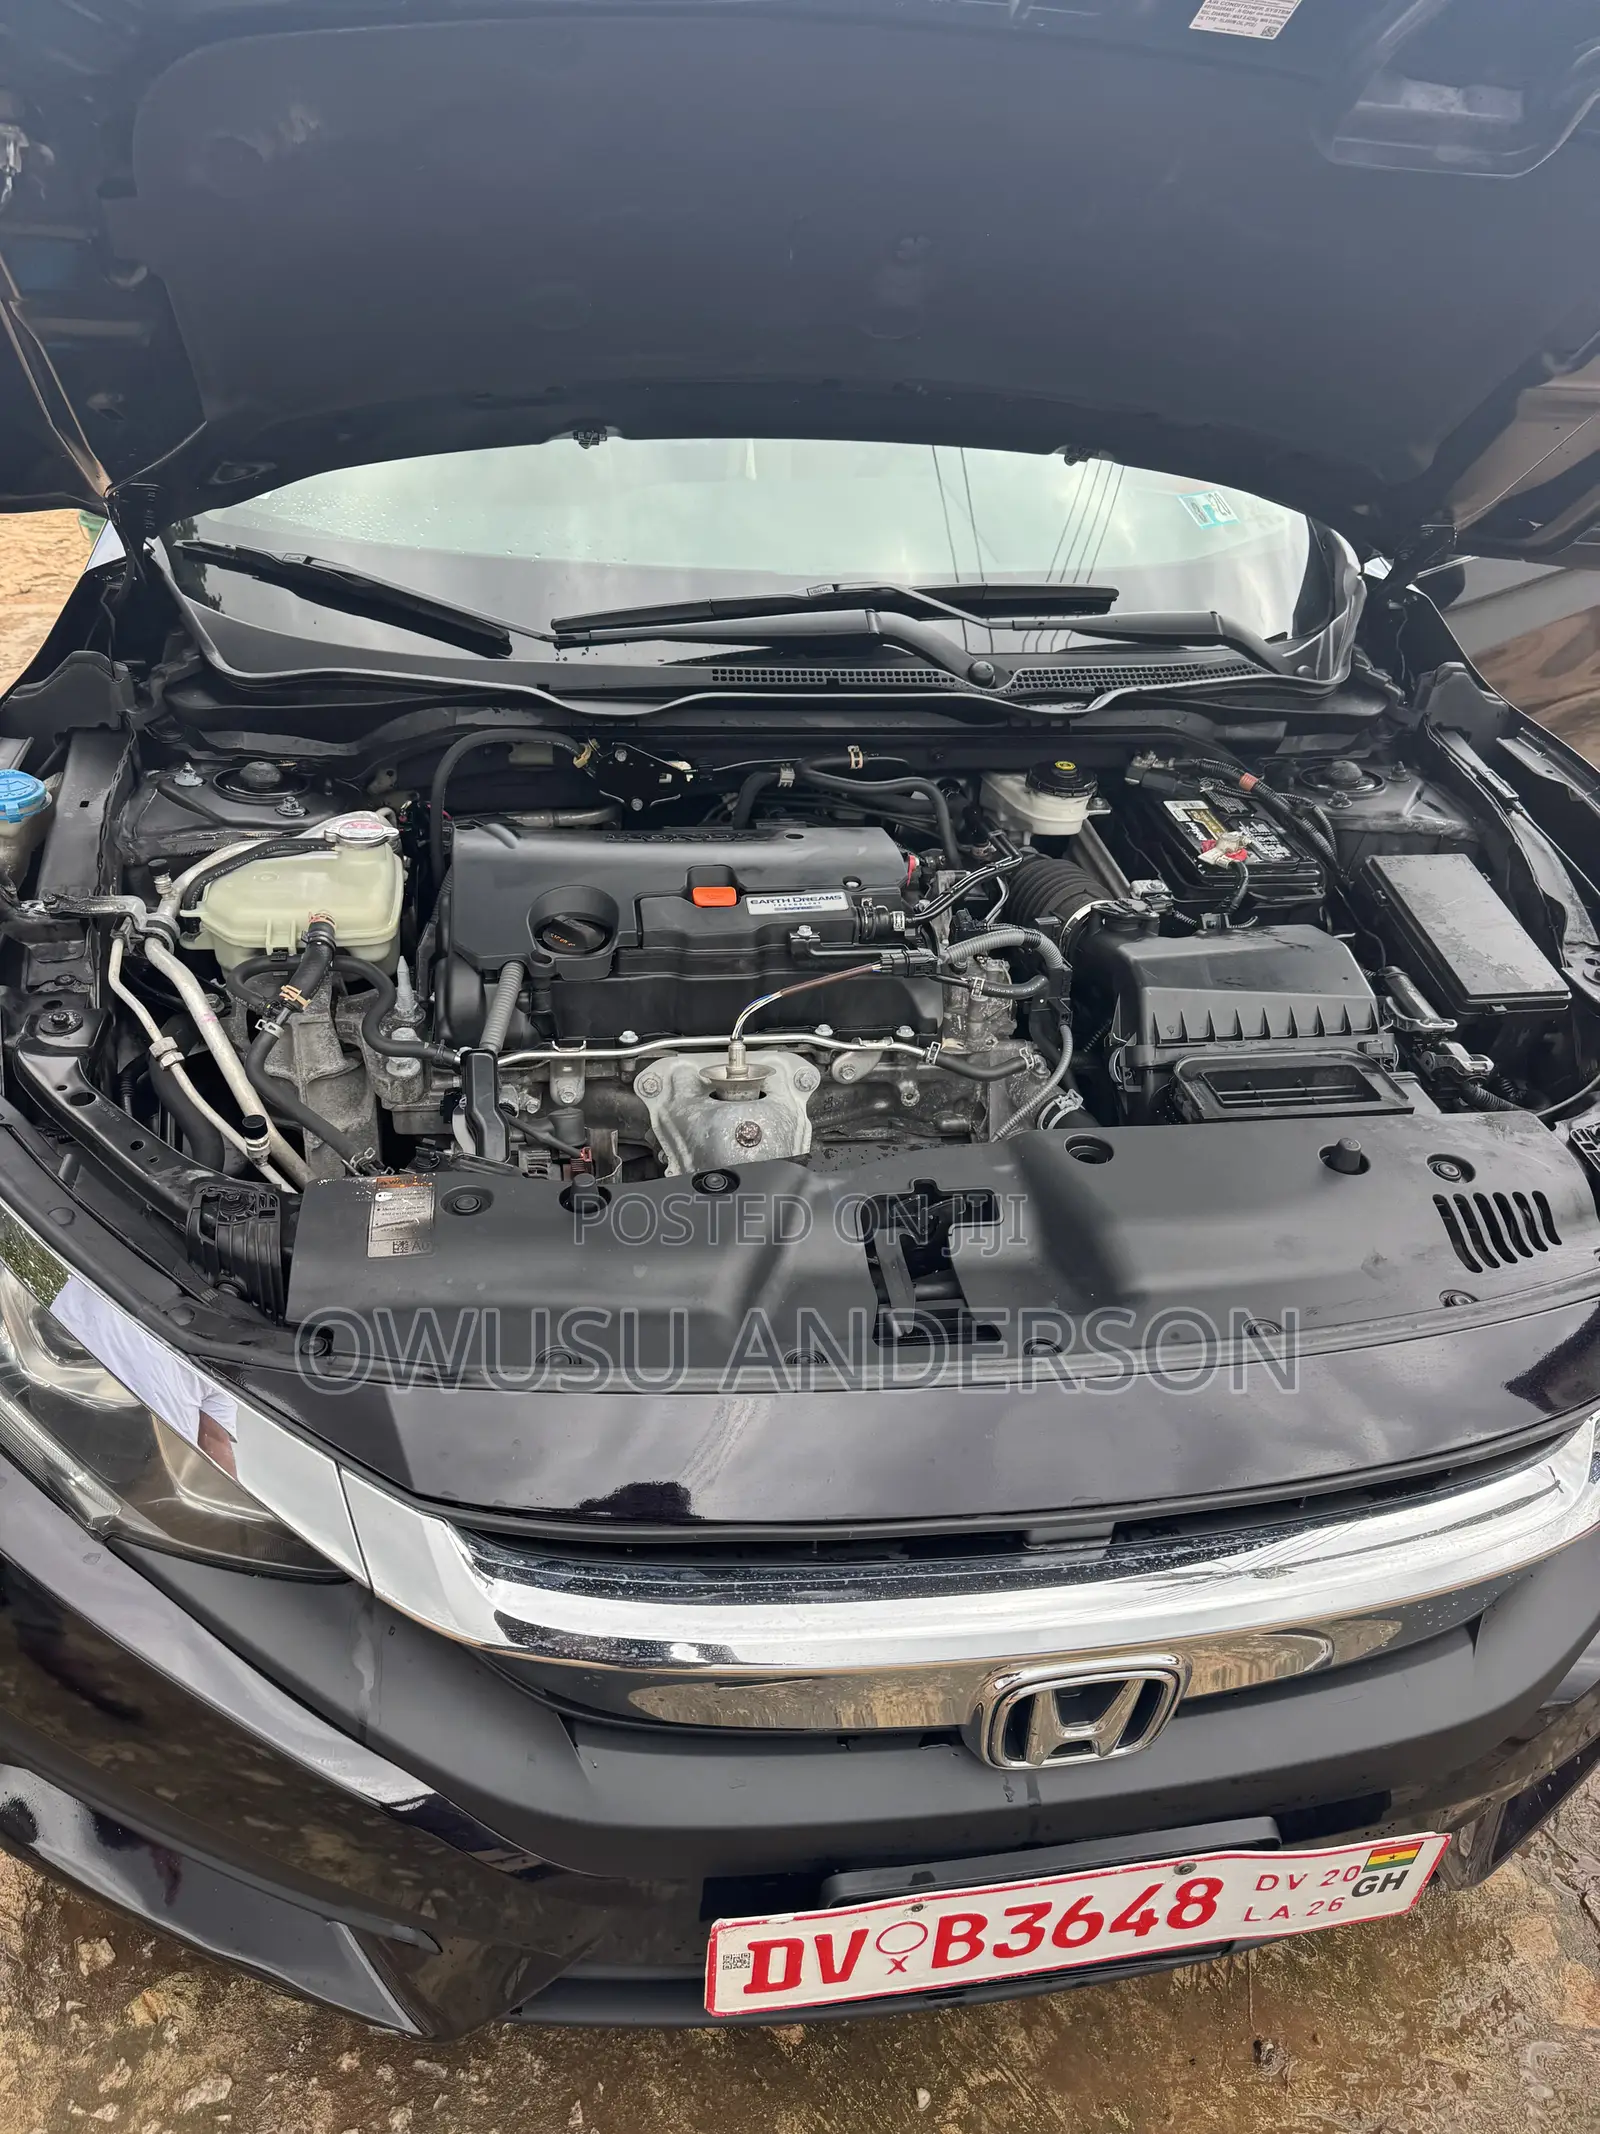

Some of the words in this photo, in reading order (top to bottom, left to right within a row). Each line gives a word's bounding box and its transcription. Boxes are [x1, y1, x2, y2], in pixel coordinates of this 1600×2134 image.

[1220, 1, 1264, 11] CONDITIONER
[750, 897, 790, 905] EARTH
[793, 894, 842, 903] DREAMS
[1255, 1873, 1309, 1892] DV
[1319, 1865, 1363, 1887] 20
[1351, 1869, 1410, 1898] GH
[1305, 1896, 1346, 1917] 26
[743, 1928, 870, 1995] DV
[930, 1876, 1225, 1970] B3648
